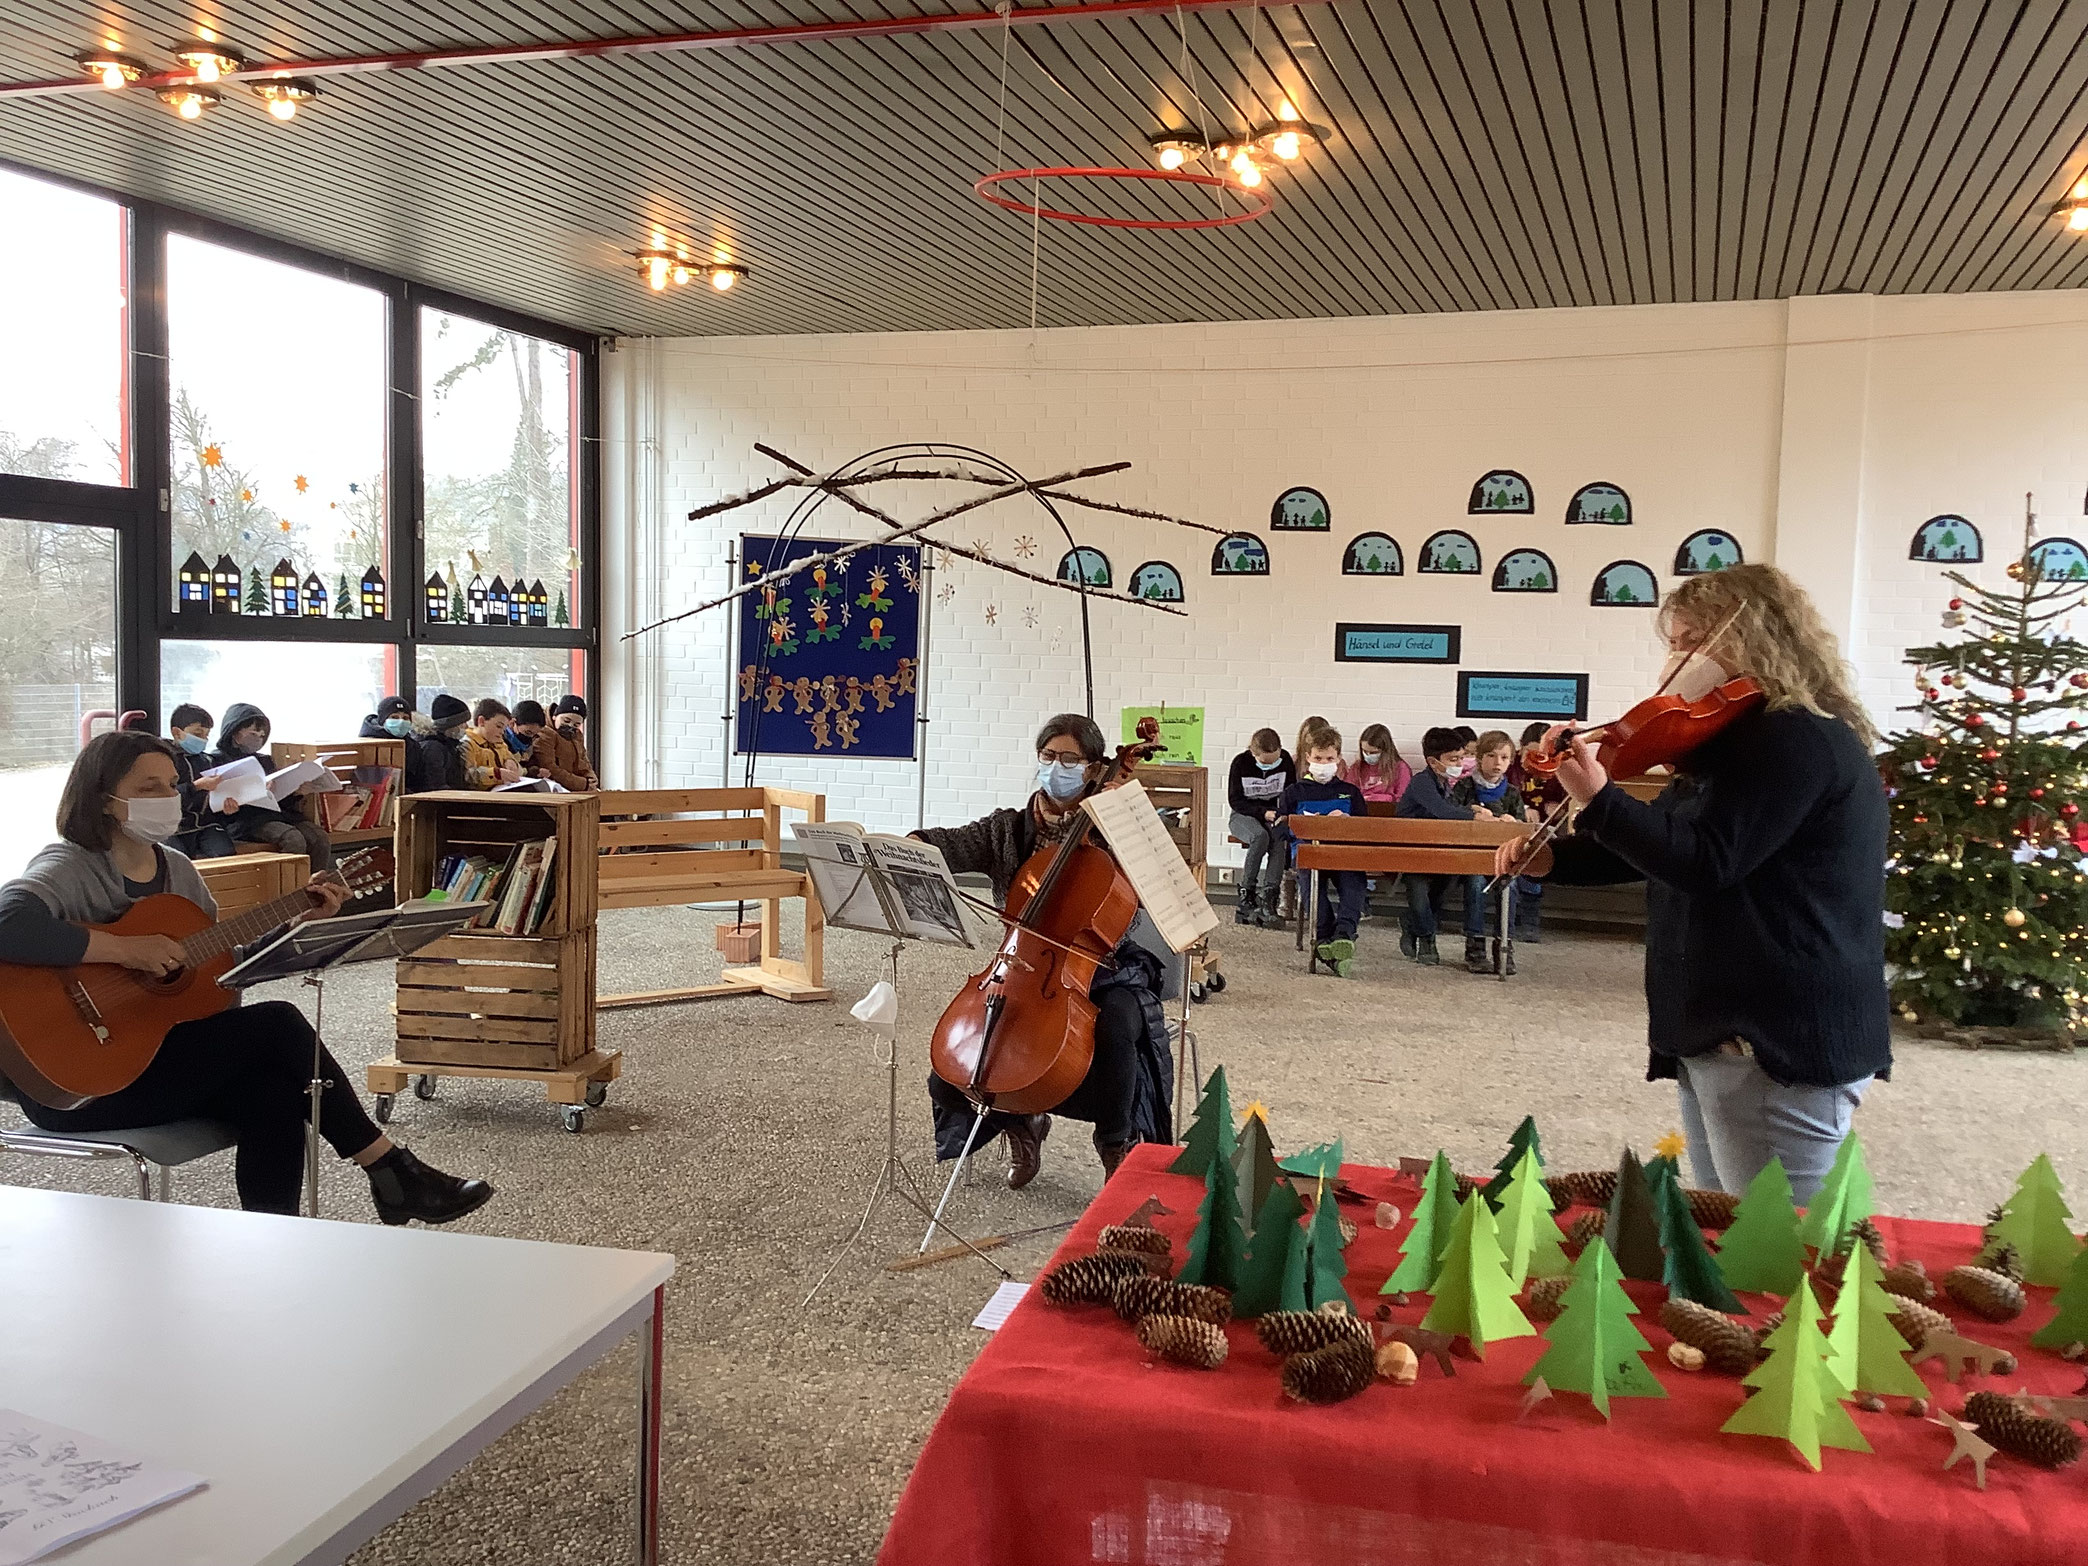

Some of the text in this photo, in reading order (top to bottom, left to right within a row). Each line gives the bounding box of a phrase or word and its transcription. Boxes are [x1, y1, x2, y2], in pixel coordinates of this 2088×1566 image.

[1348, 636, 1434, 650] Hänsel und Gretel
[873, 848, 941, 869] Weihnachtslieder
[881, 842, 926, 859] Das Buch der
